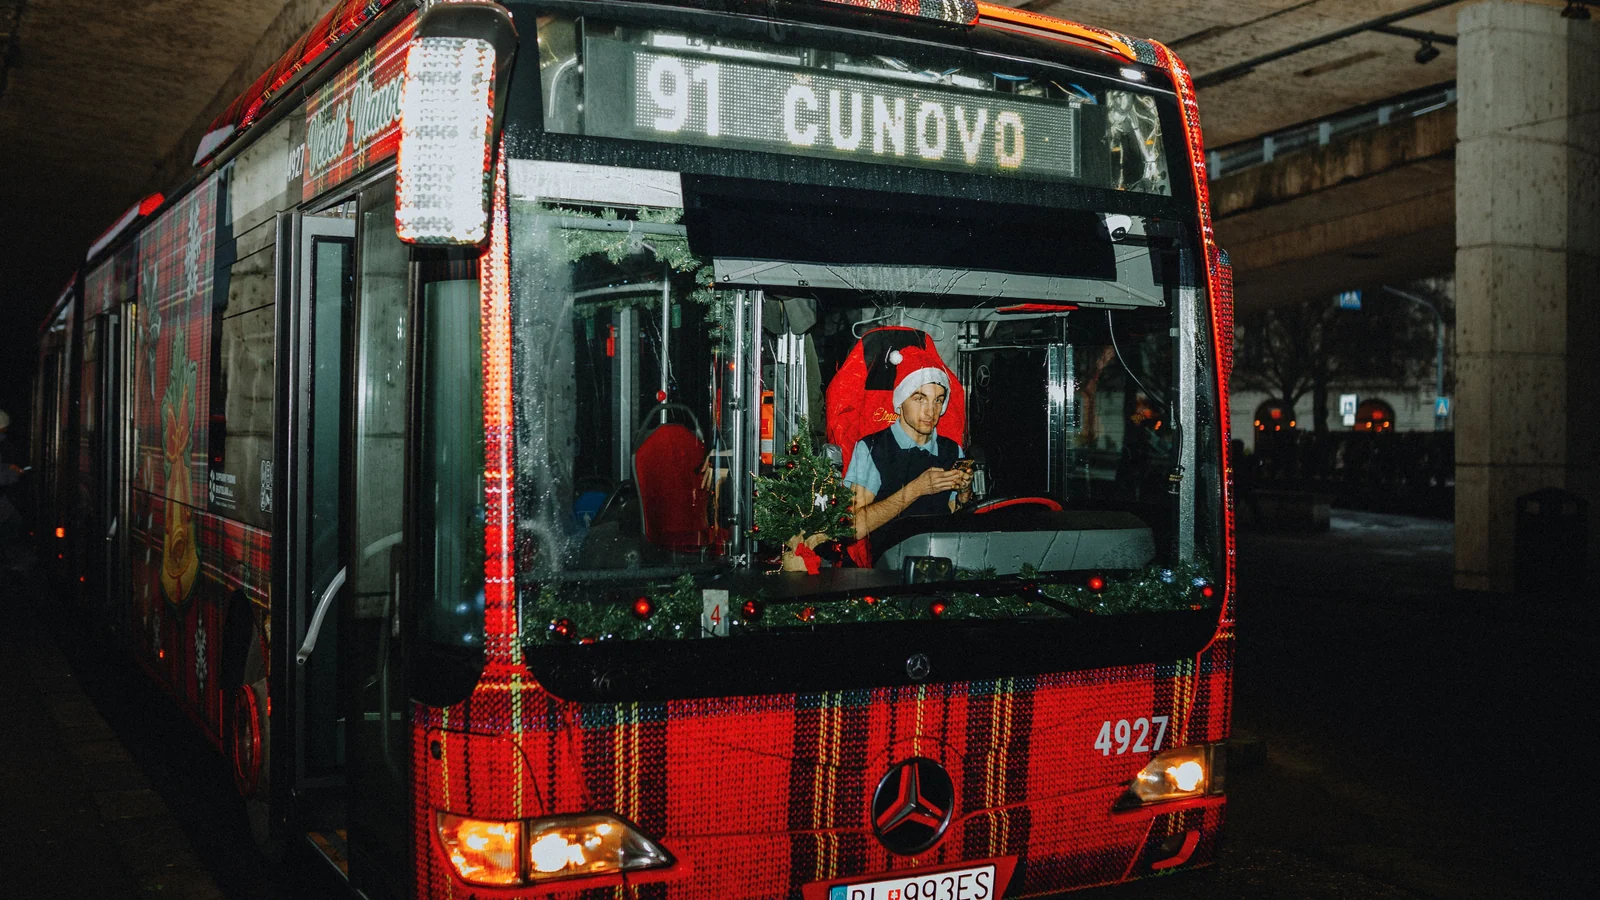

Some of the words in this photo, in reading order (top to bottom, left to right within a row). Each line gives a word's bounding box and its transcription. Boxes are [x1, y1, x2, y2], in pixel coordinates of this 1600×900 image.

[307, 99, 349, 177] Veselé
[350, 71, 405, 150] Vianoc
[647, 55, 720, 137] 91
[783, 73, 1026, 169] ČUNOVO
[287, 143, 306, 182] 4927
[710, 604, 721, 625] 4
[1094, 715, 1169, 757] 4927
[904, 871, 990, 900] 993ES
